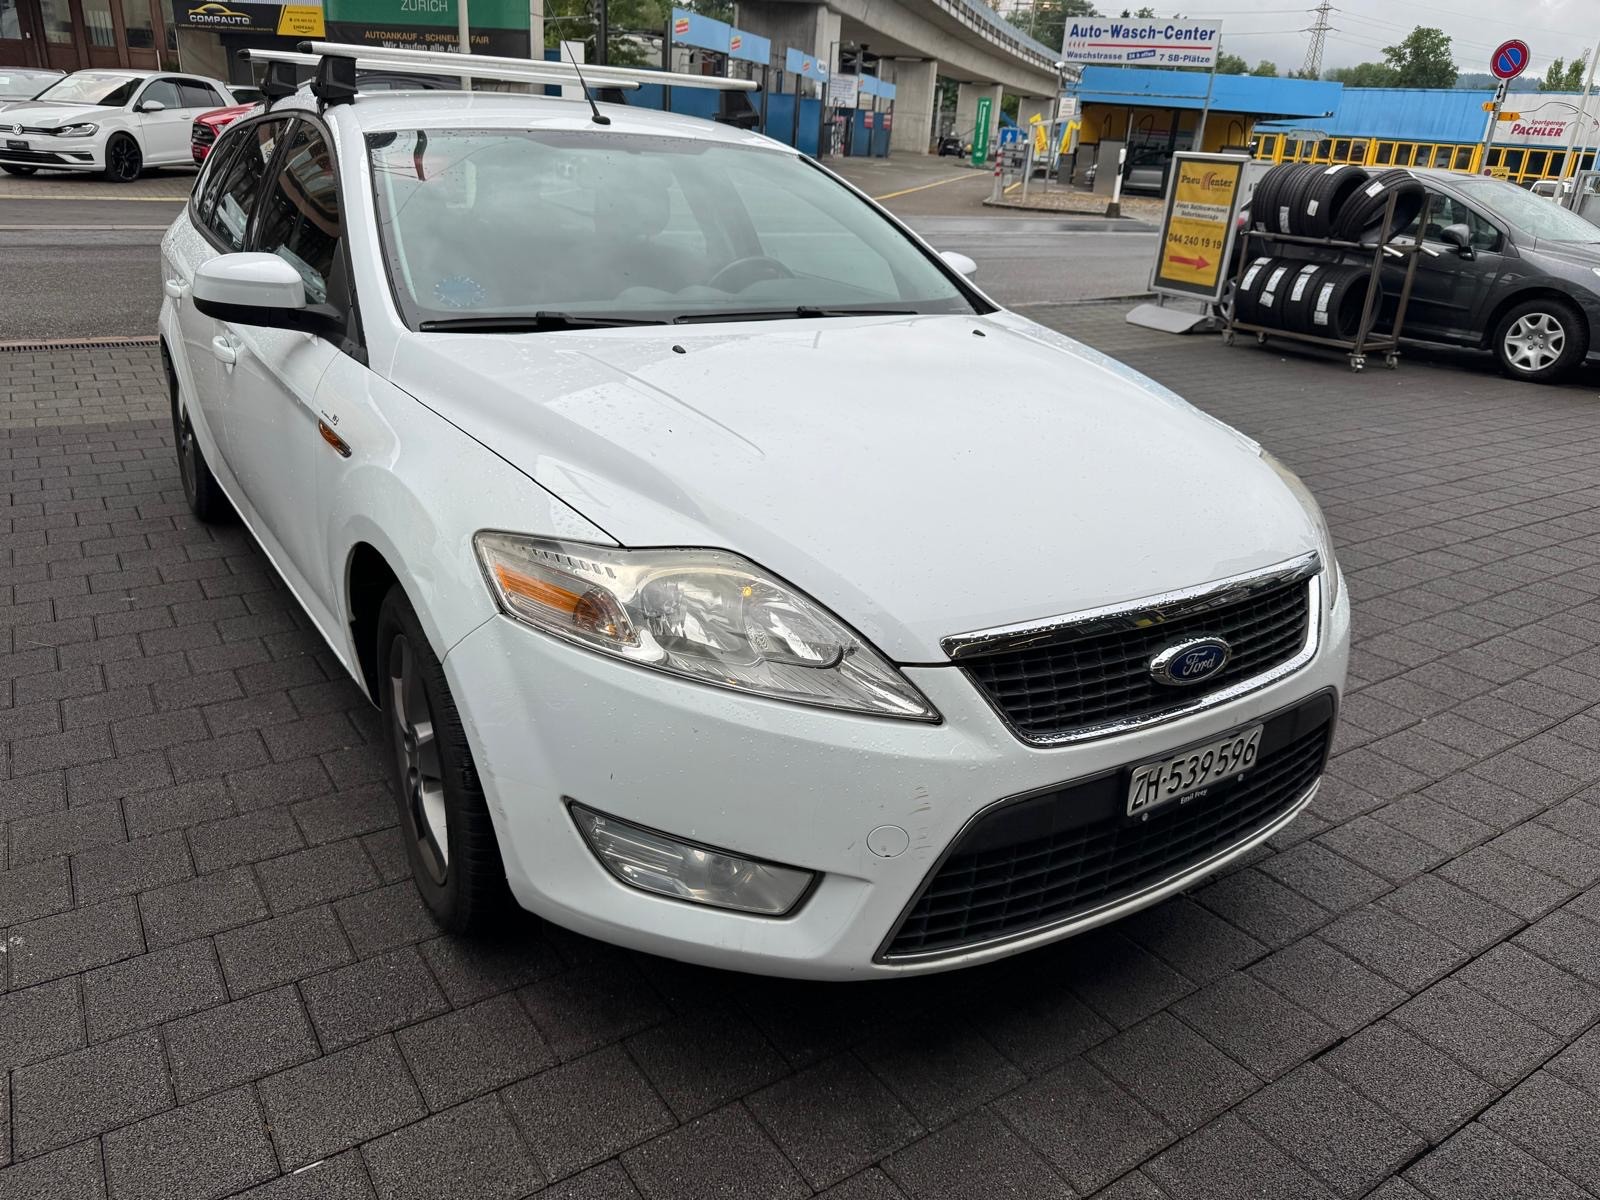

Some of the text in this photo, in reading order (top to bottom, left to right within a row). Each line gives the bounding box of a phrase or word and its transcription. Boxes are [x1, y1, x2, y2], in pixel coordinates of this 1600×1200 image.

[189, 15, 250, 25] COMPAUTO
[365, 31, 418, 41] AUTOANKAUF
[471, 35, 490, 45] FAIR
[1069, 23, 1216, 41] Auto-Wasch-Center
[382, 41, 398, 49] Wir
[399, 41, 428, 51] kaufen
[430, 43, 445, 52] alle
[1066, 50, 1123, 61] Waschstrasse
[1159, 53, 1211, 64] 7 SB-Plätze
[1510, 123, 1564, 137] PACHLER
[1181, 174, 1200, 185] Pneu
[1168, 232, 1223, 250] 044 240 19 19
[1182, 649, 1216, 677] Ford
[1180, 792, 1194, 805] Emil
